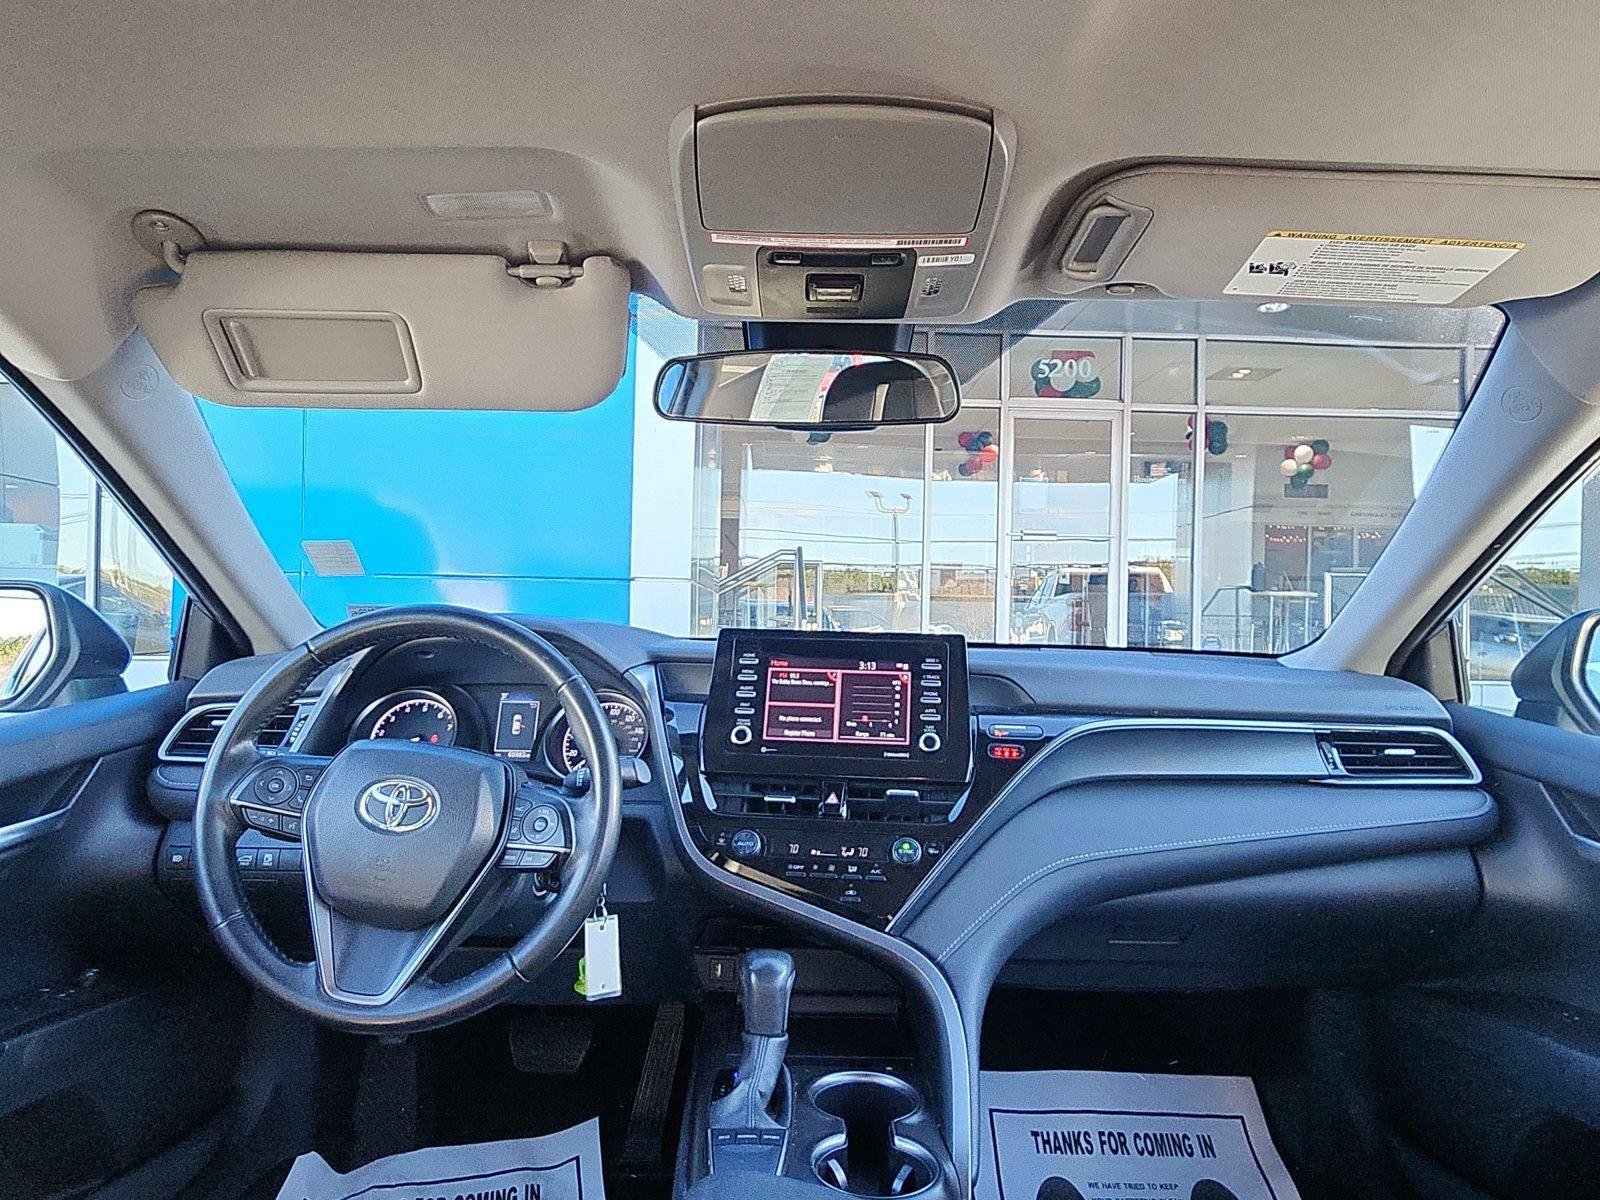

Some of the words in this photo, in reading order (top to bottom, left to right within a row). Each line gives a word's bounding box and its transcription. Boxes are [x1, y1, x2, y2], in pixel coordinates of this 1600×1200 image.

[1286, 231, 1338, 240] WARNING
[1344, 234, 1435, 245] AVERTISSEMENT
[1441, 239, 1519, 249] ADVERTENCIA
[1037, 358, 1092, 378] 5200
[858, 661, 877, 670] 3:13
[610, 708, 621, 716] 100
[625, 714, 636, 722] 120
[568, 749, 578, 757] 20
[788, 843, 800, 854] 70
[857, 846, 869, 858] 70
[1030, 1129, 1094, 1156] THANKS
[1097, 1130, 1132, 1156] FOR
[1132, 1131, 1195, 1158] COMING
[1195, 1133, 1218, 1159] IN
[524, 1183, 541, 1200] IN
[1086, 1181, 1100, 1190] WE
[1101, 1182, 1121, 1190] HAVE
[1123, 1182, 1146, 1191] TRIED
[1146, 1182, 1158, 1190] TO
[1159, 1183, 1179, 1191] KEEP
